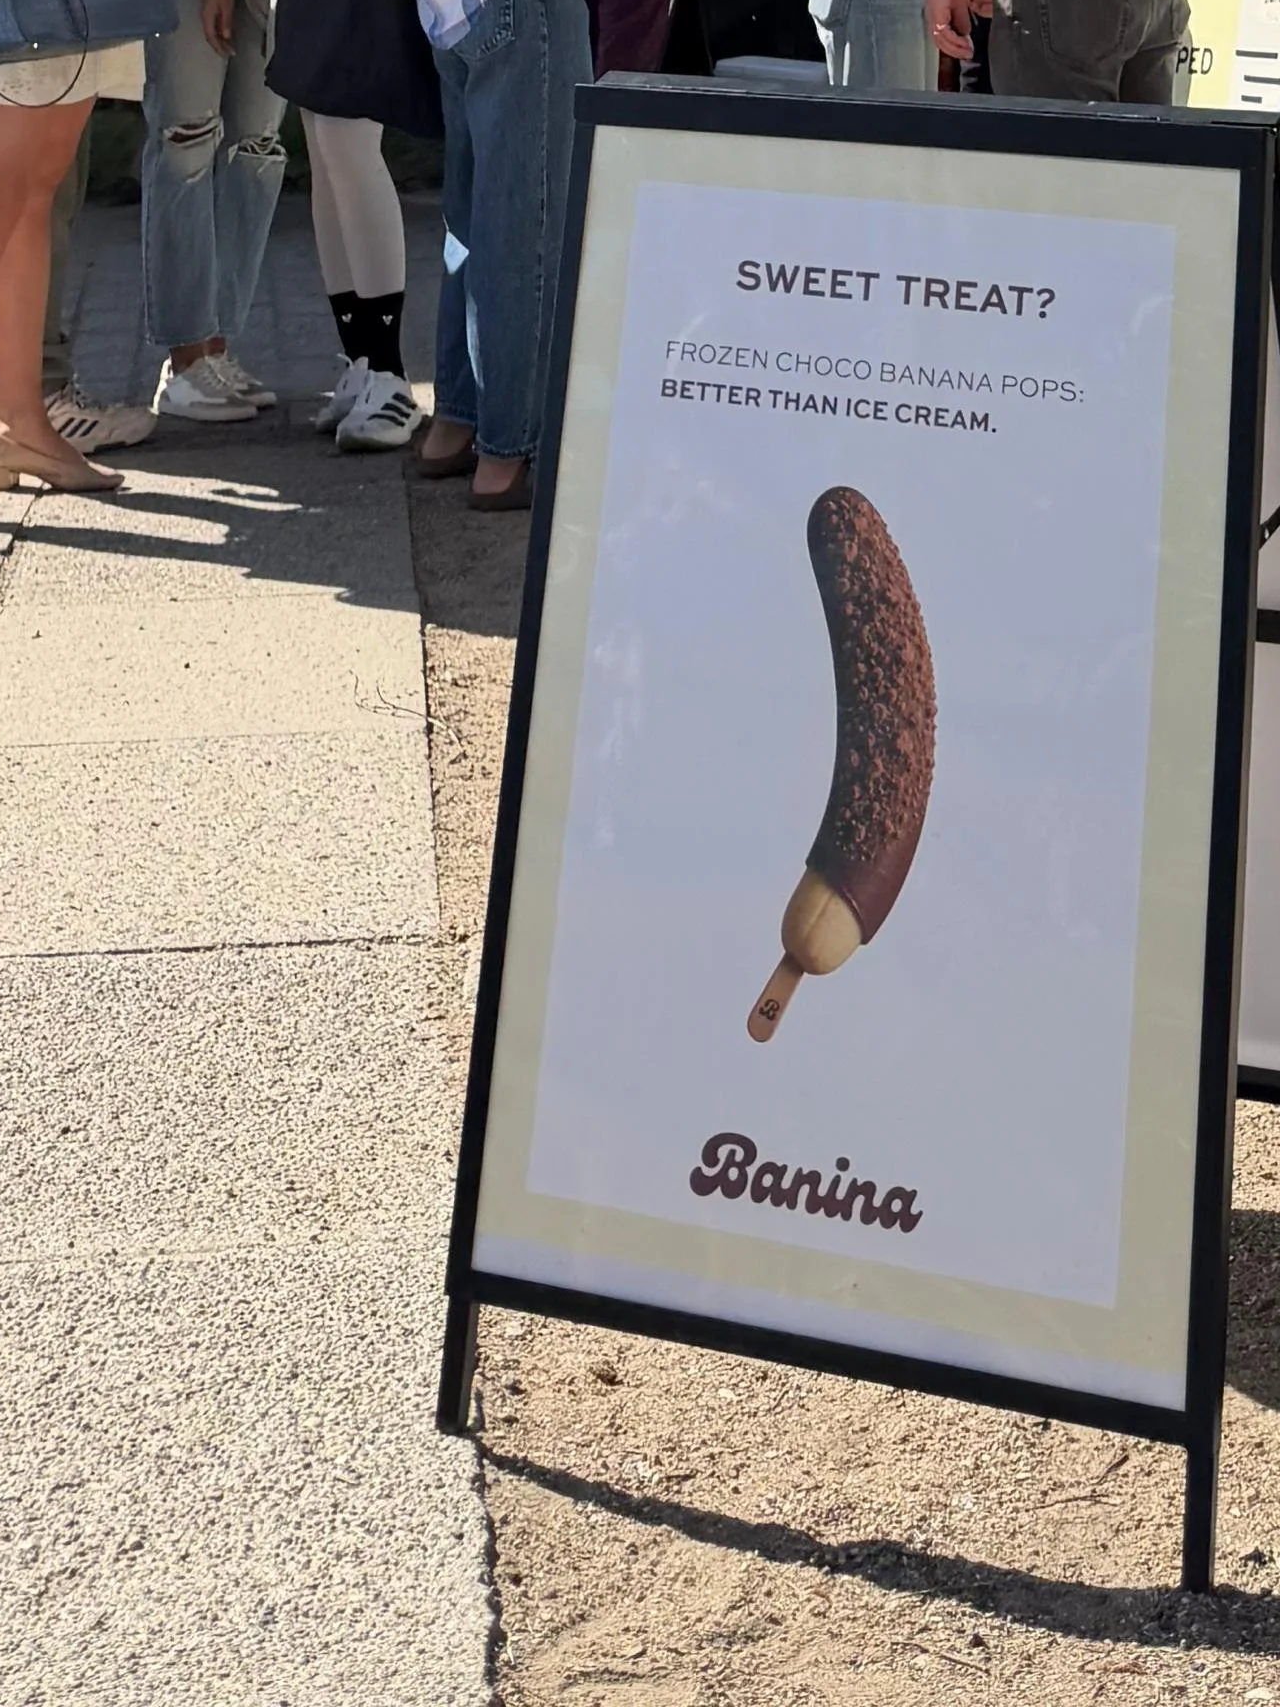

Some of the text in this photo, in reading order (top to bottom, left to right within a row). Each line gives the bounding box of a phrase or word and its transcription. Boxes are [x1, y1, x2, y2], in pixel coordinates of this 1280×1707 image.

[1175, 46, 1213, 75] PED
[735, 260, 1057, 319] SWEET TREAT?
[665, 340, 1085, 403] FROZEN CHOCO BANANA POPS:
[660, 378, 998, 434] BETTER THAN ICE CREAM.
[689, 1132, 924, 1234] Banina
